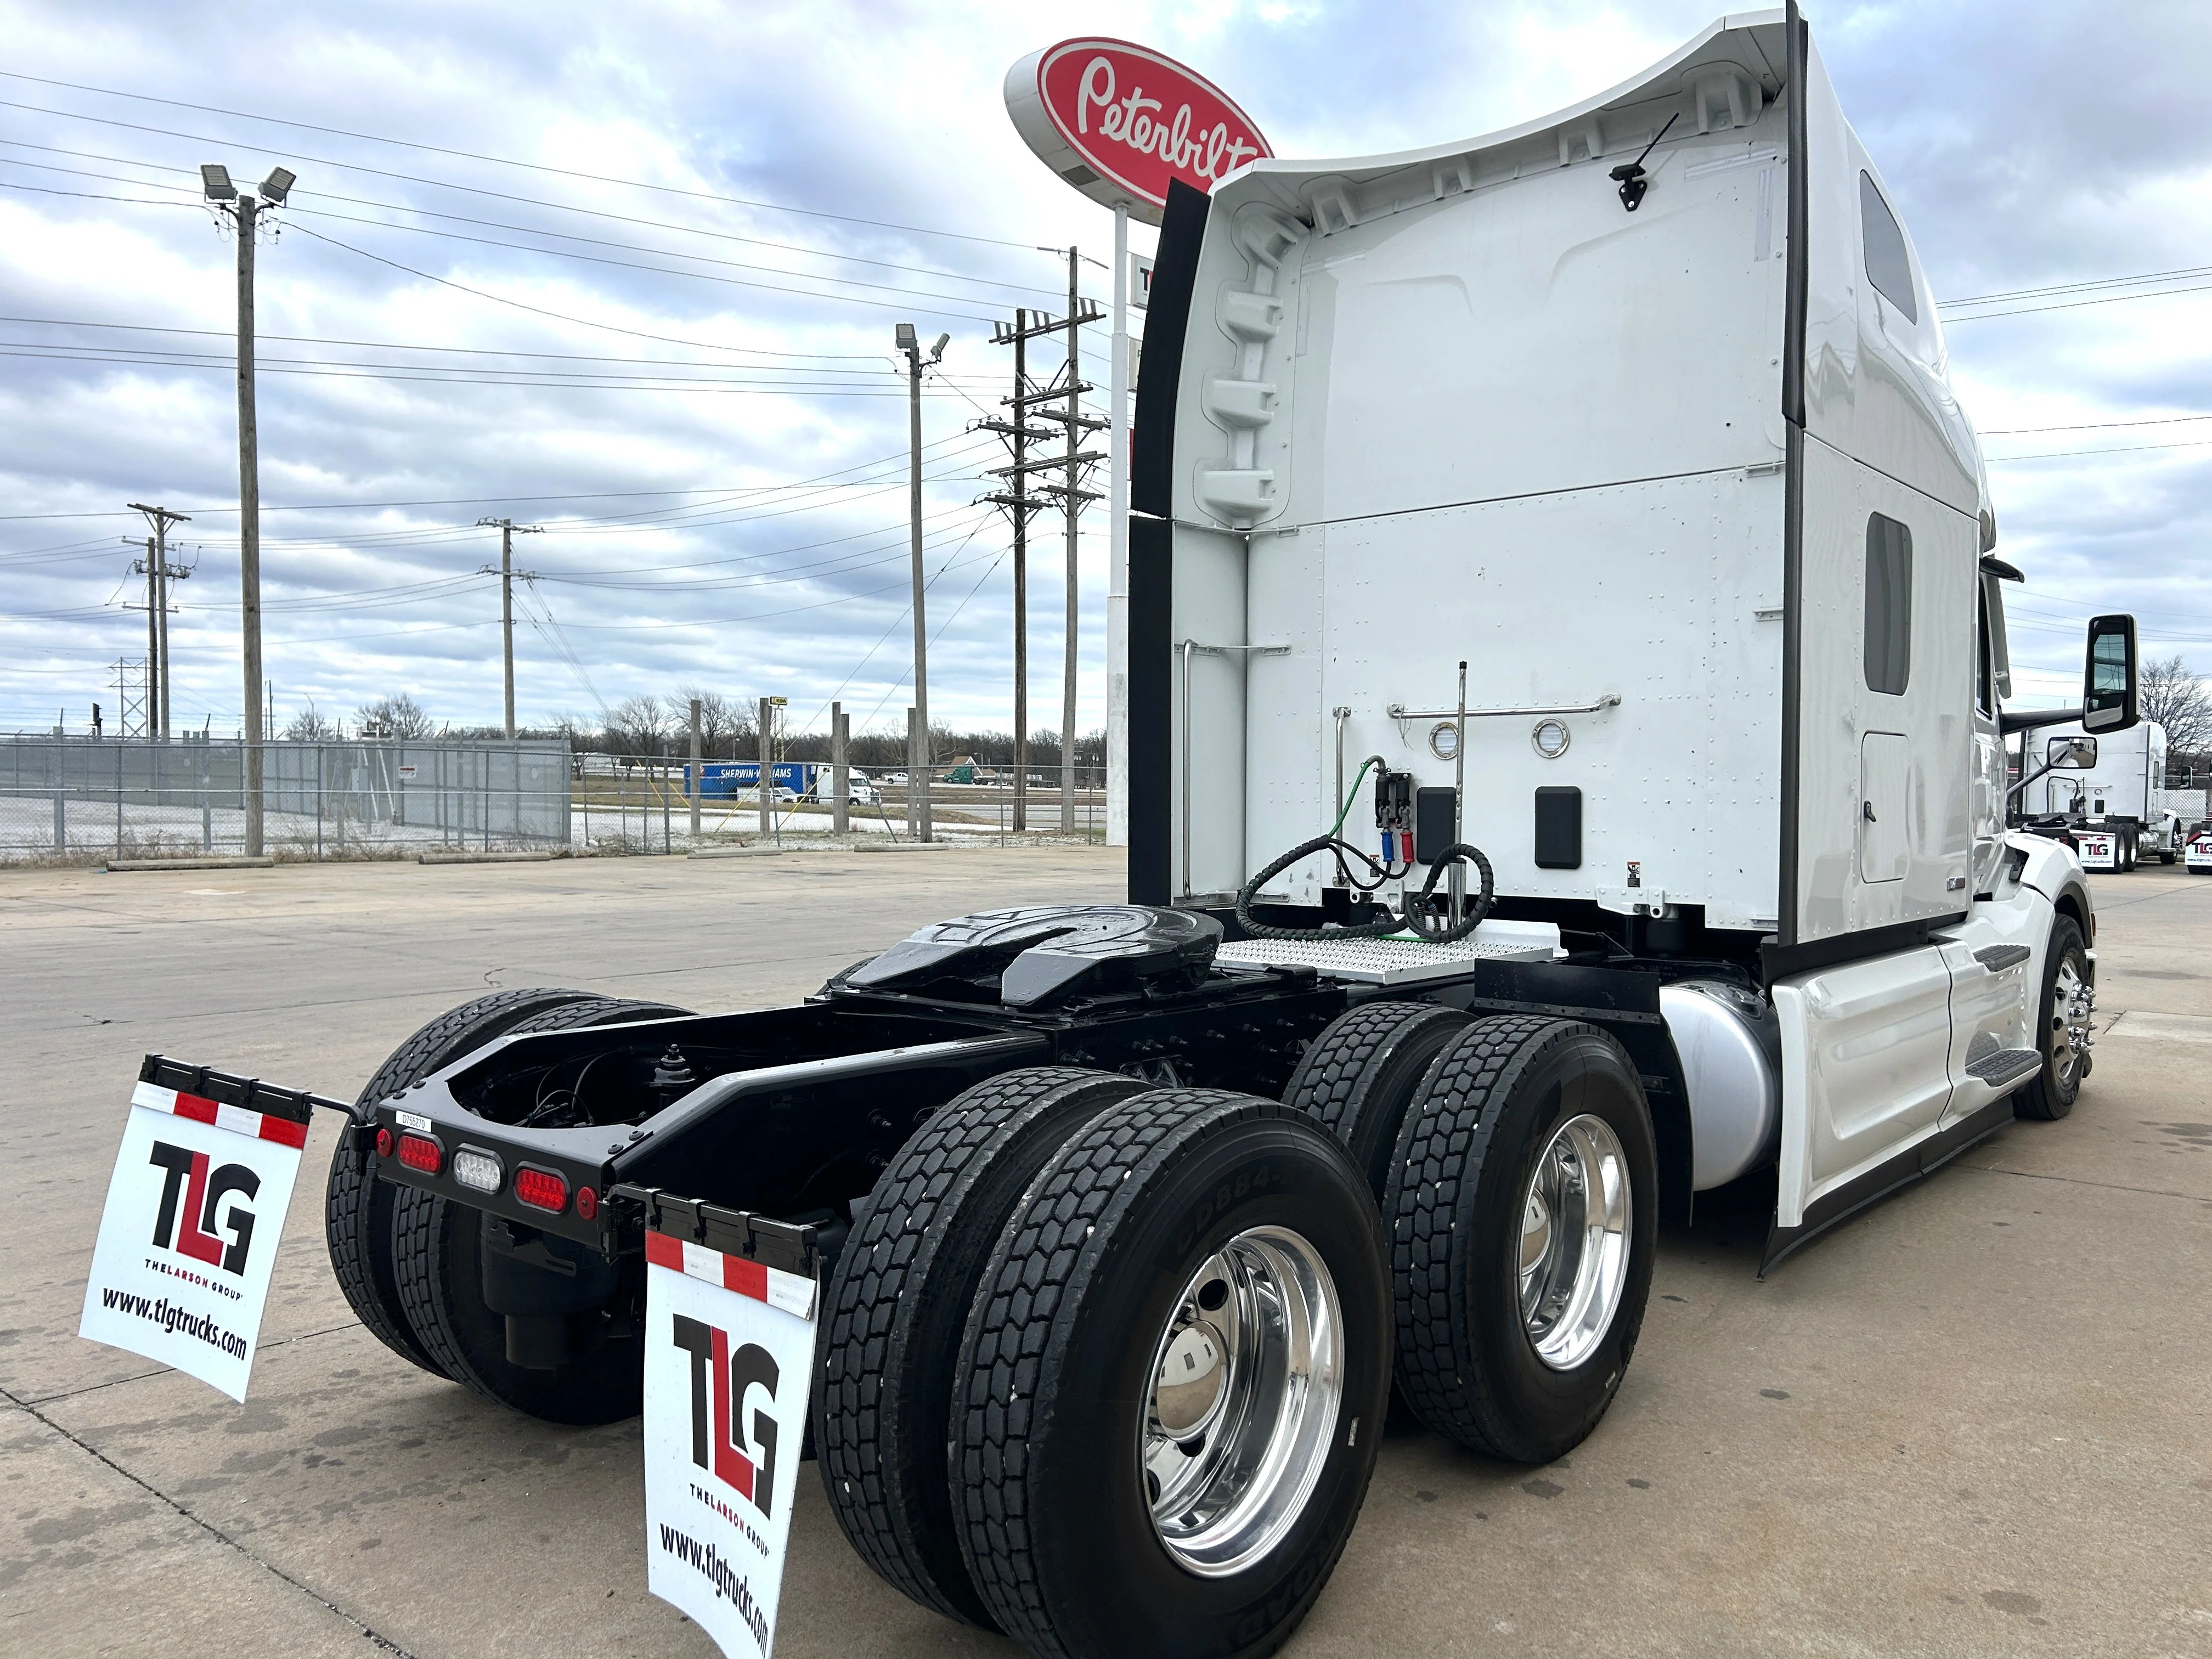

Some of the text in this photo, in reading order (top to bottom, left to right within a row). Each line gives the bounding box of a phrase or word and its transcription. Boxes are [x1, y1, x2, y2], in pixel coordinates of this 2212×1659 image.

[1077, 55, 1258, 182] Peterbilt
[2085, 844, 2108, 855] TLG
[402, 1114, 425, 1129] D755270
[149, 1140, 261, 1277] TLG
[103, 1287, 247, 1361] www.tlgtrucks.com
[212, 1282, 241, 1301] GROUP
[673, 1313, 780, 1520] TLG
[747, 1525, 768, 1559] GROUP
[660, 1522, 768, 1659] www.tlgtrucks.com
